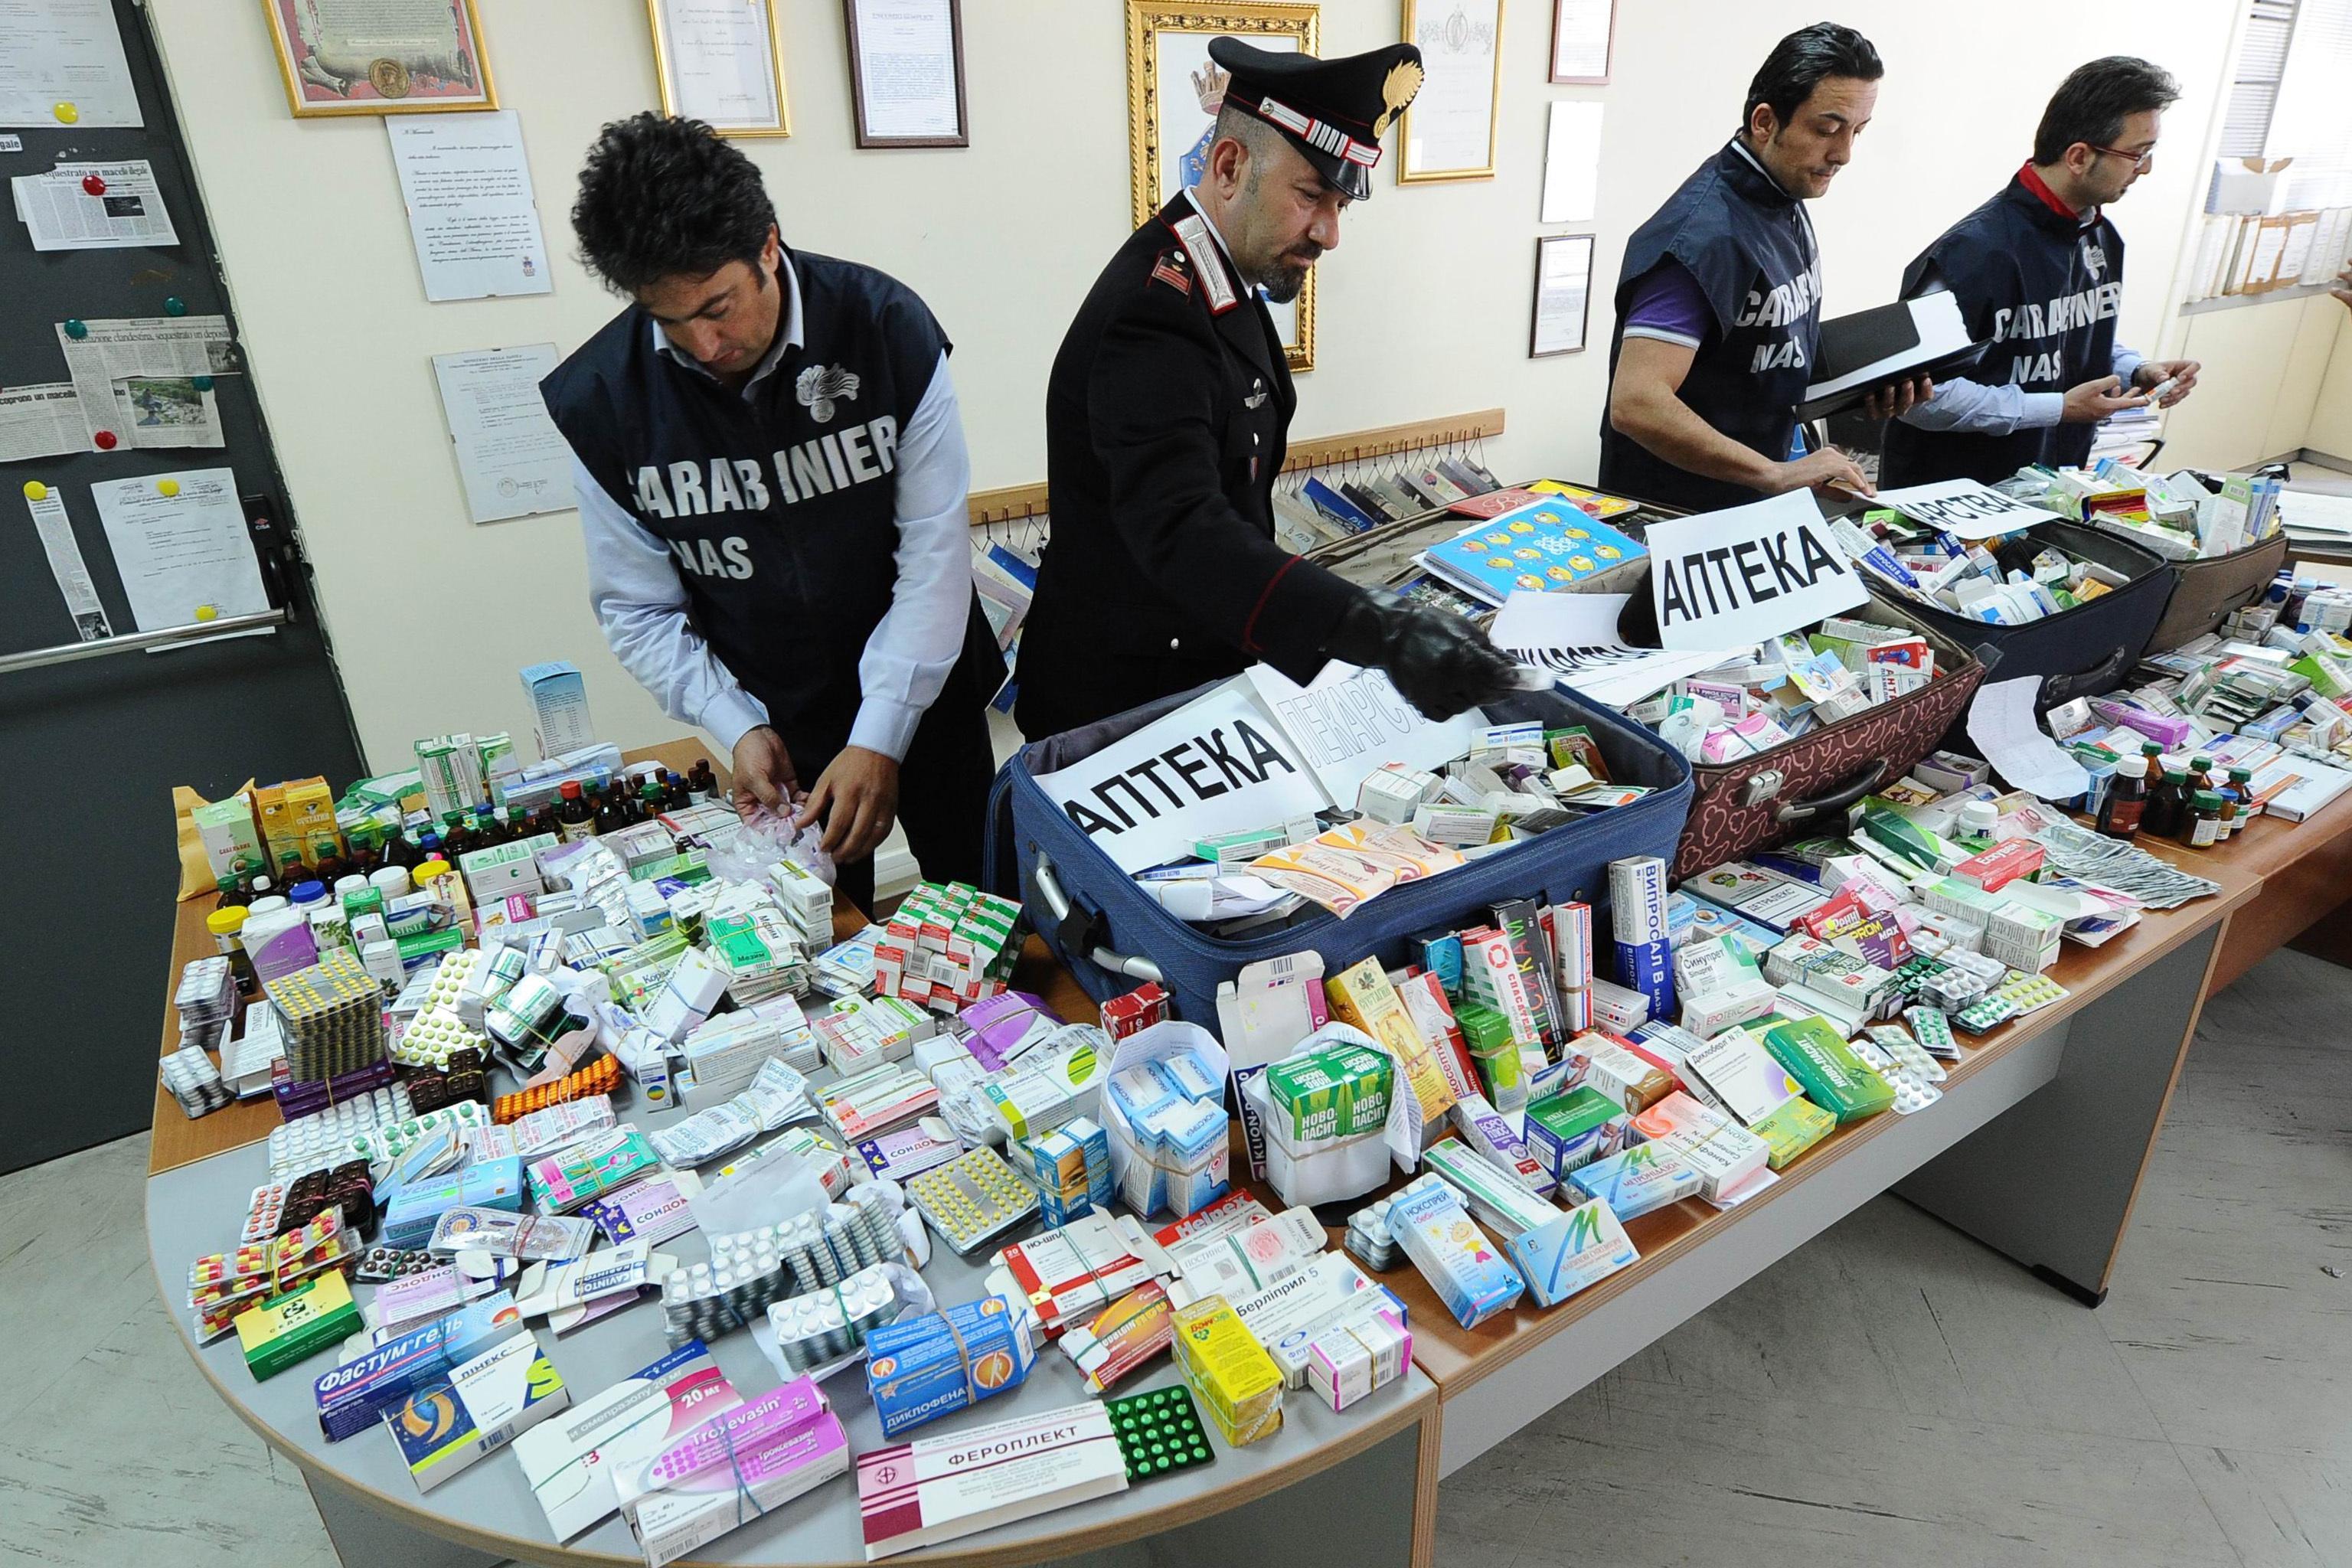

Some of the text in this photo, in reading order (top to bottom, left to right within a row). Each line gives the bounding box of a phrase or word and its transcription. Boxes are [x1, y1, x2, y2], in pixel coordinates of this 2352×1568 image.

[1750, 335, 1805, 374] NAS
[2011, 350, 2063, 384] NAS
[627, 415, 898, 520] ARABINIER
[668, 536, 753, 580] NAS
[1664, 524, 1844, 628] АПТЕКА
[1062, 718, 1297, 838] АПТЕКА
[1645, 864, 1664, 968] ВИПРОСАЛ
[1746, 887, 1796, 913] ДЕТРАЛЕКС
[1879, 926, 1900, 942] MAX
[1626, 946, 1637, 990] ВІПРОСА
[1684, 948, 1726, 970] Синупрет
[1652, 971, 1665, 985] В
[1507, 972, 1535, 1040] СПАСАТЕЛЬ
[1706, 1004, 1745, 1027] ЕРОТЕКС
[1302, 1107, 1338, 1129] НОВО-
[1352, 1091, 1386, 1112] НОВО-
[1352, 1107, 1387, 1128] ПАСИТ
[1302, 1122, 1338, 1142] ПАСИТ
[1175, 1195, 1246, 1238] Helpex
[1404, 1191, 1449, 1218] НОКСПРЕЙ
[1005, 1247, 1019, 1257] 20
[1236, 1266, 1319, 1318] Берліприл 5
[318, 1338, 410, 1393] Фастум
[680, 1388, 704, 1410] 20
[886, 1386, 969, 1430] ДИКЛОФЕНА
[690, 1395, 781, 1447] Troxevasin
[756, 1427, 815, 1462] Троксевазин
[948, 1426, 1078, 1467] ФЕРОПЛЕКТ
